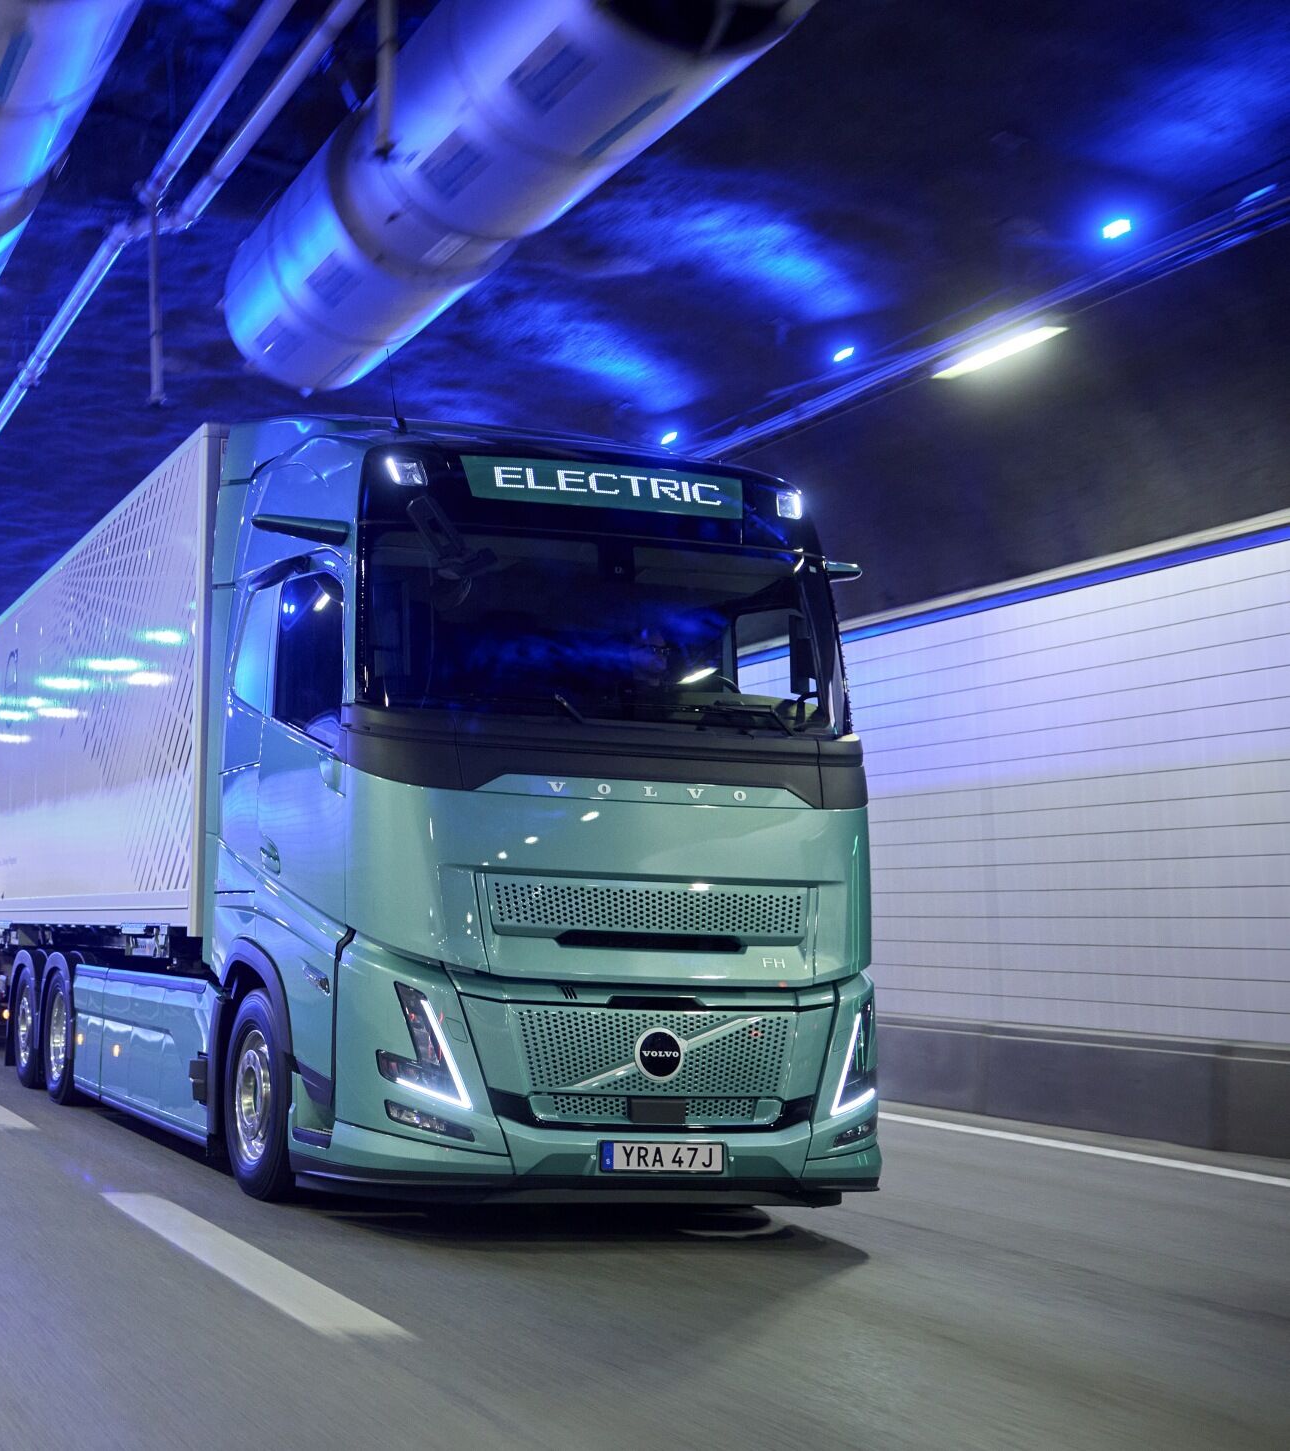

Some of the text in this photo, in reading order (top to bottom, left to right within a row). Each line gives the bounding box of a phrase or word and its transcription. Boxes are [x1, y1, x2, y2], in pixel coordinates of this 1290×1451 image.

[493, 466, 722, 505] ELECTRIC
[547, 781, 747, 801] VOLVO
[762, 957, 786, 969] FH
[641, 1050, 680, 1058] VOLVO
[622, 1145, 713, 1168] YRA 47J
